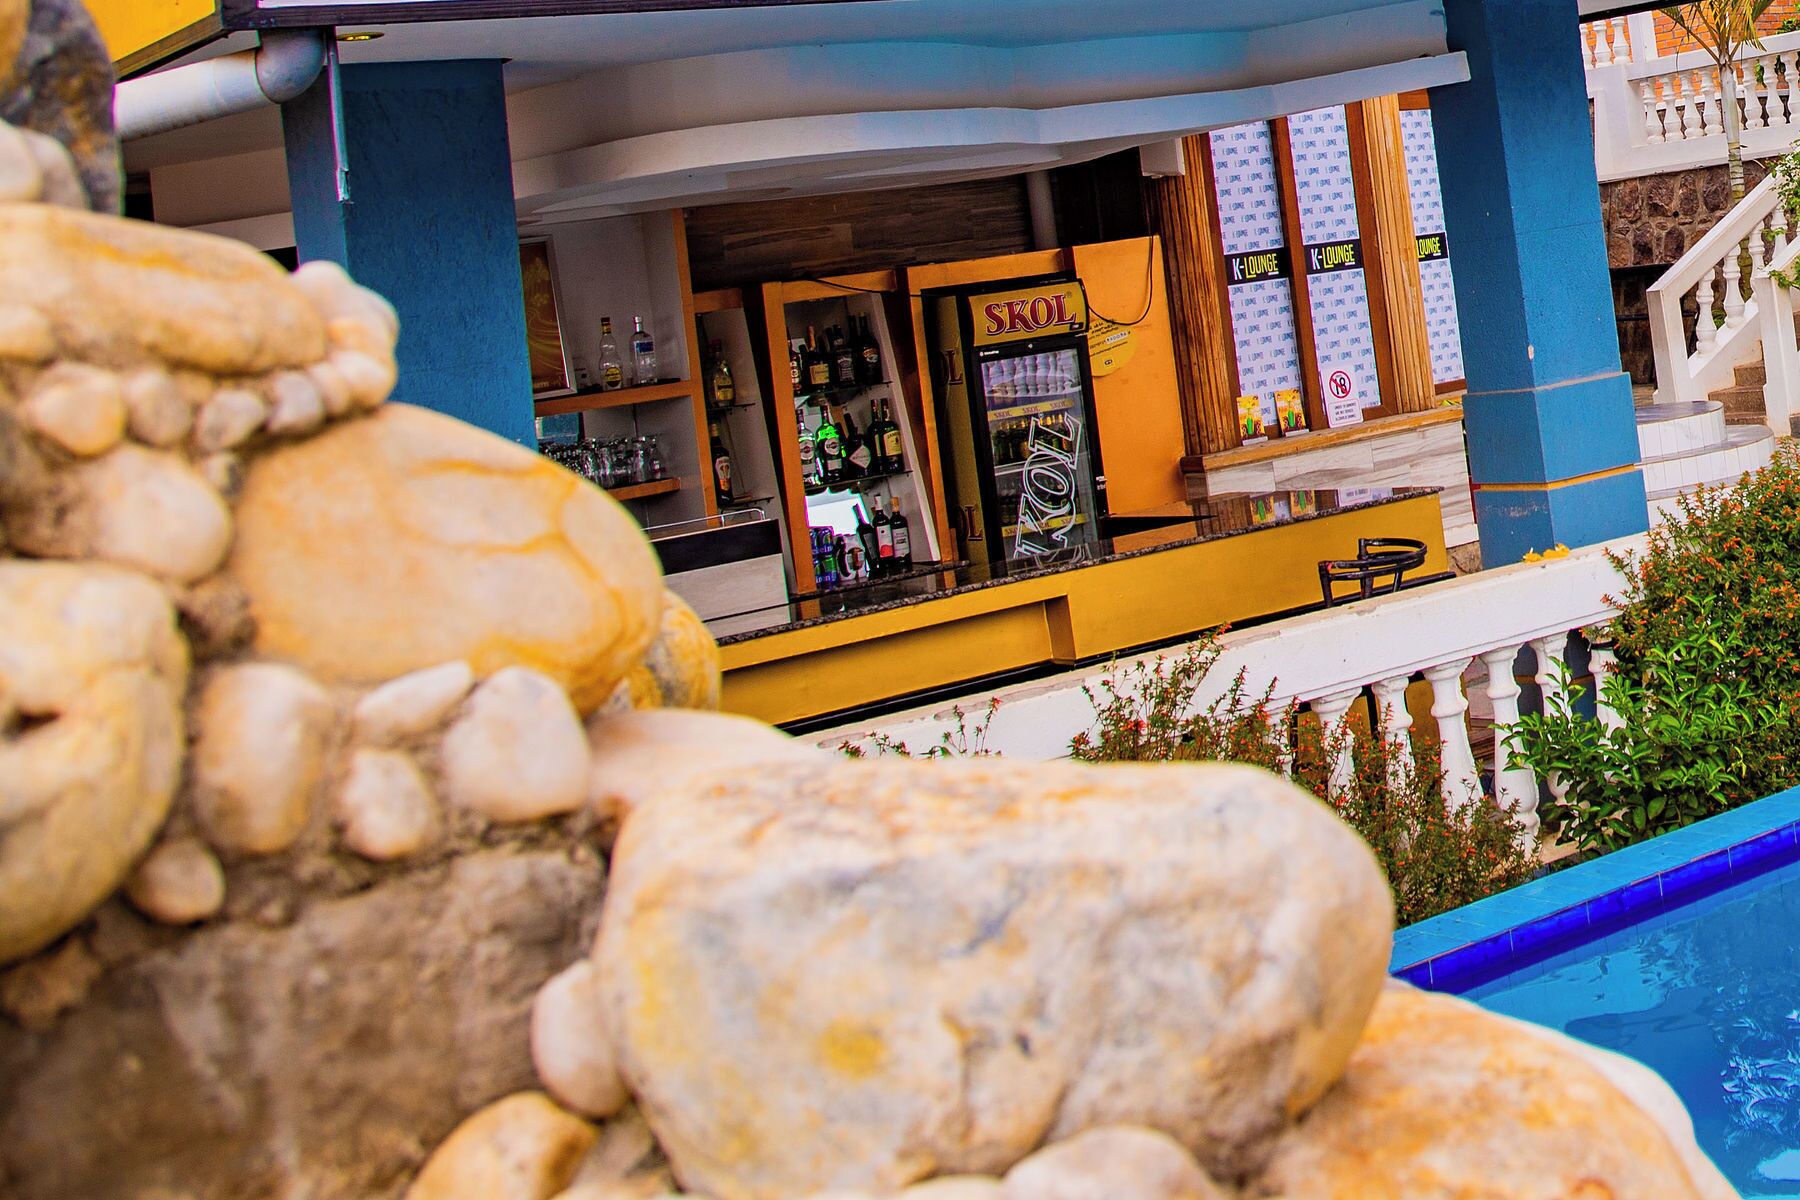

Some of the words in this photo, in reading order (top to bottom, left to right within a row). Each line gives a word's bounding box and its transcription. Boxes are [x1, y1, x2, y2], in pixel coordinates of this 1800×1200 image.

[1232, 253, 1279, 280] K-LOUNGE
[1311, 244, 1356, 270] K-LOUNGE
[984, 294, 1076, 336] SKOL
